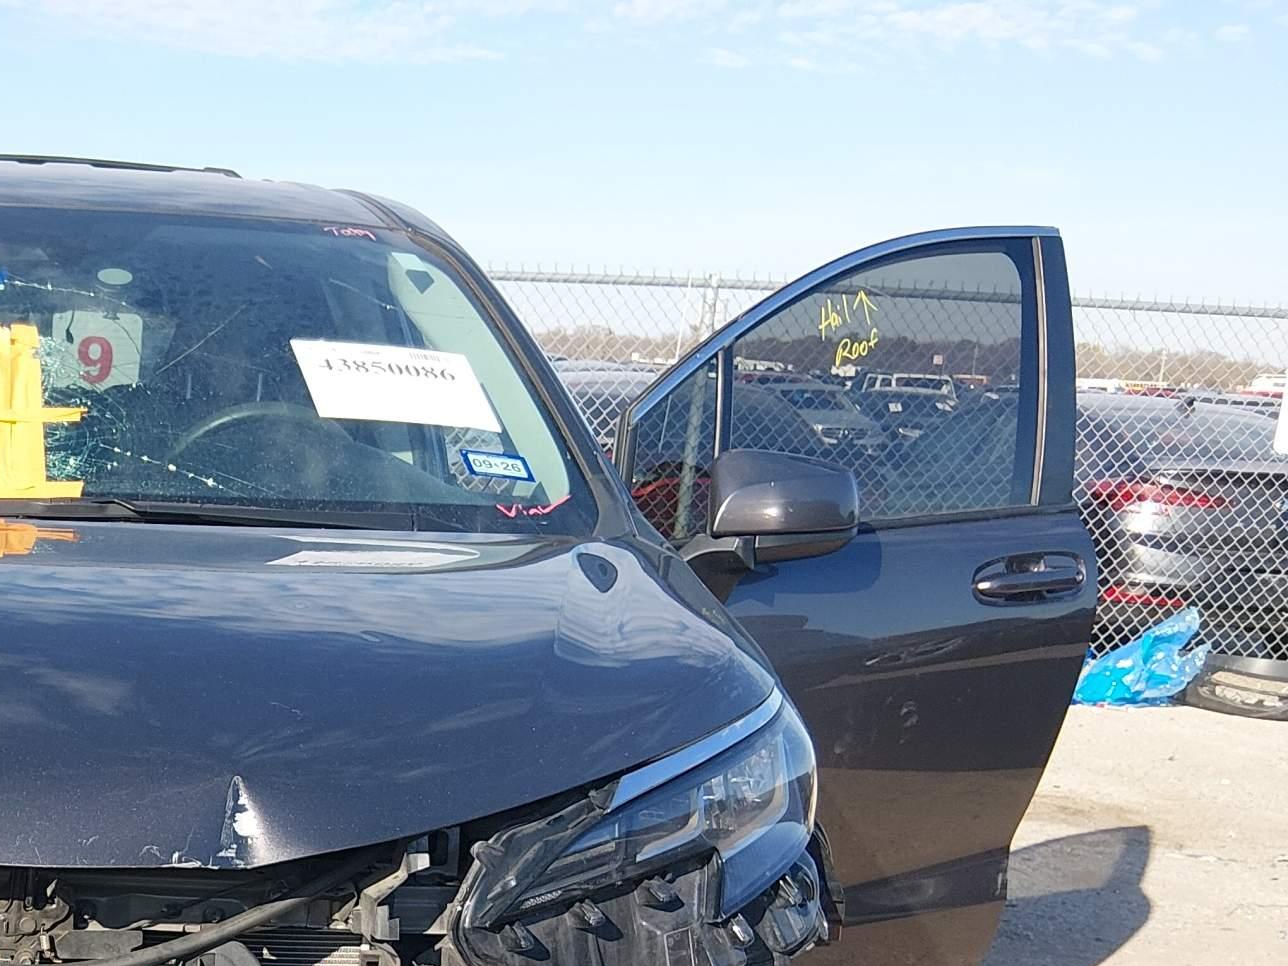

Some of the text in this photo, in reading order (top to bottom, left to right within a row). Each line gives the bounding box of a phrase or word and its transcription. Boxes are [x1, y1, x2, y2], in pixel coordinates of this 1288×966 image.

[818, 294, 851, 341] Hail
[77, 335, 114, 384] 9
[319, 358, 457, 382] 43850086
[836, 327, 879, 369] Roof
